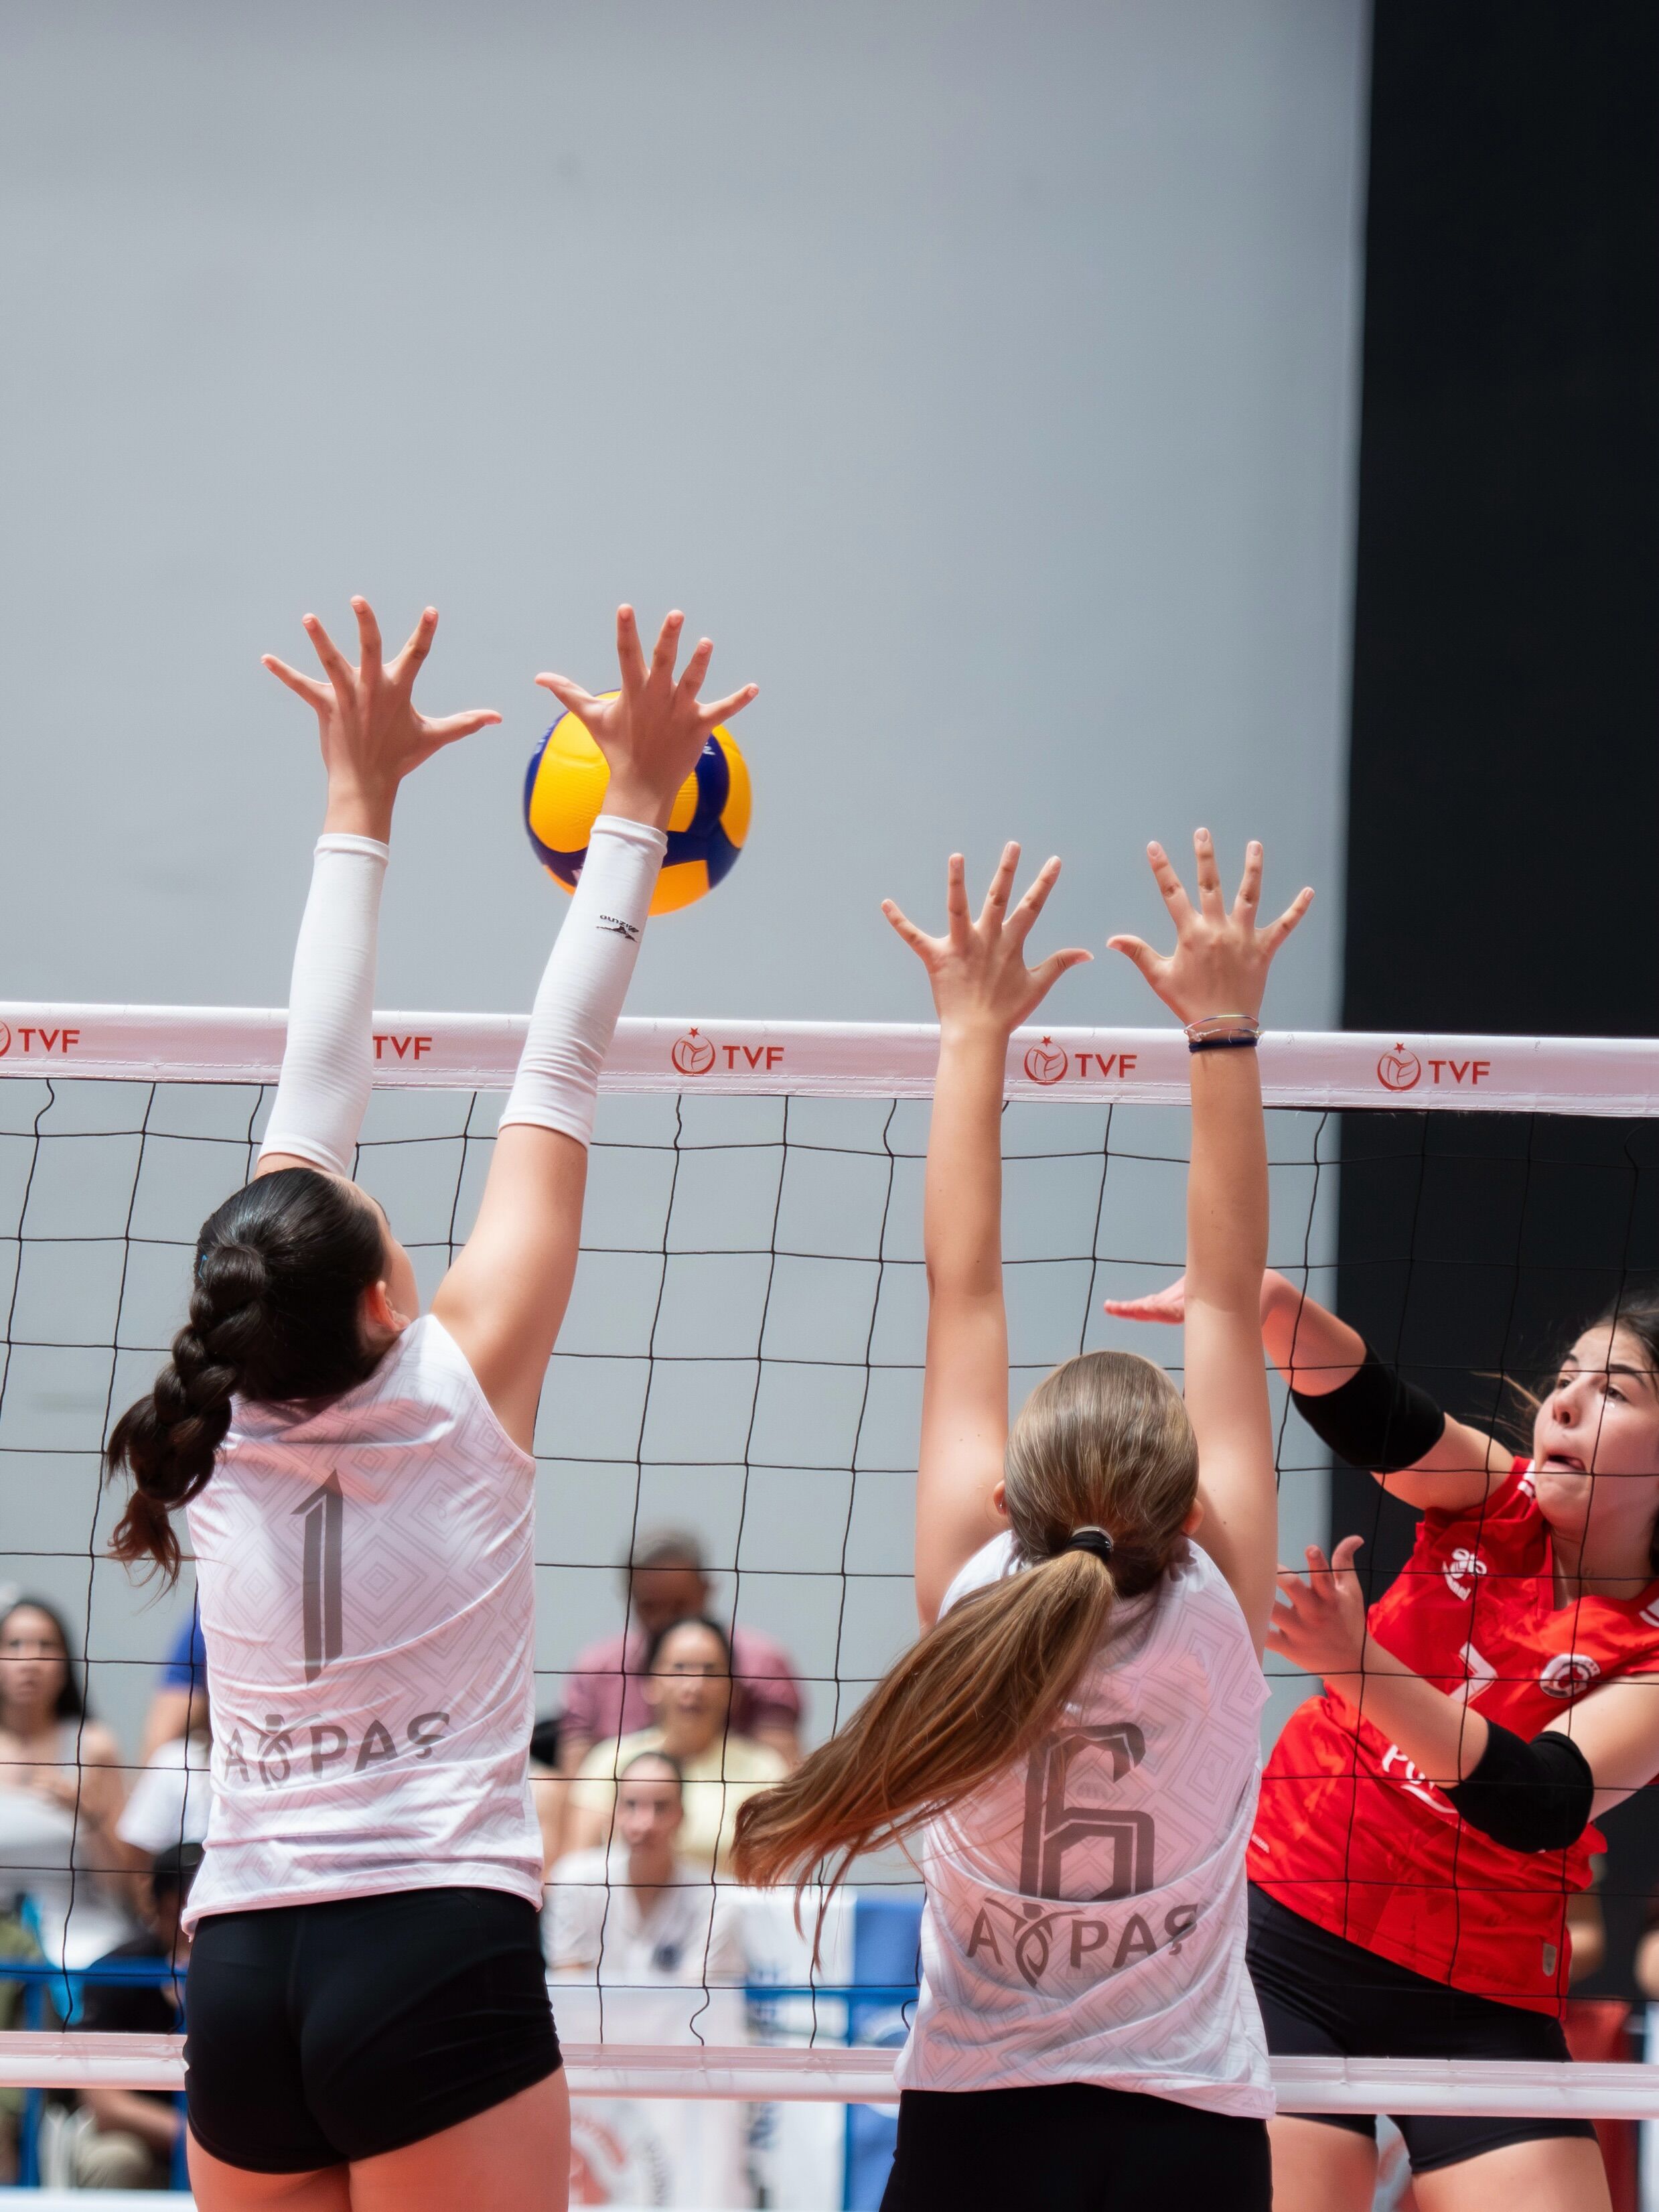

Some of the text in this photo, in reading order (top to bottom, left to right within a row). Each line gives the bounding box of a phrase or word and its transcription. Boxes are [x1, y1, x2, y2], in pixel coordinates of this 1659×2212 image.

[18, 1029, 80, 1052] TVF
[372, 1036, 431, 1059] TVF
[723, 1046, 783, 1069] TVF
[1076, 1054, 1136, 1077] TVF
[1429, 1060, 1490, 1084] TVF
[290, 1469, 343, 1685] 1
[1019, 1722, 1155, 1903] 6
